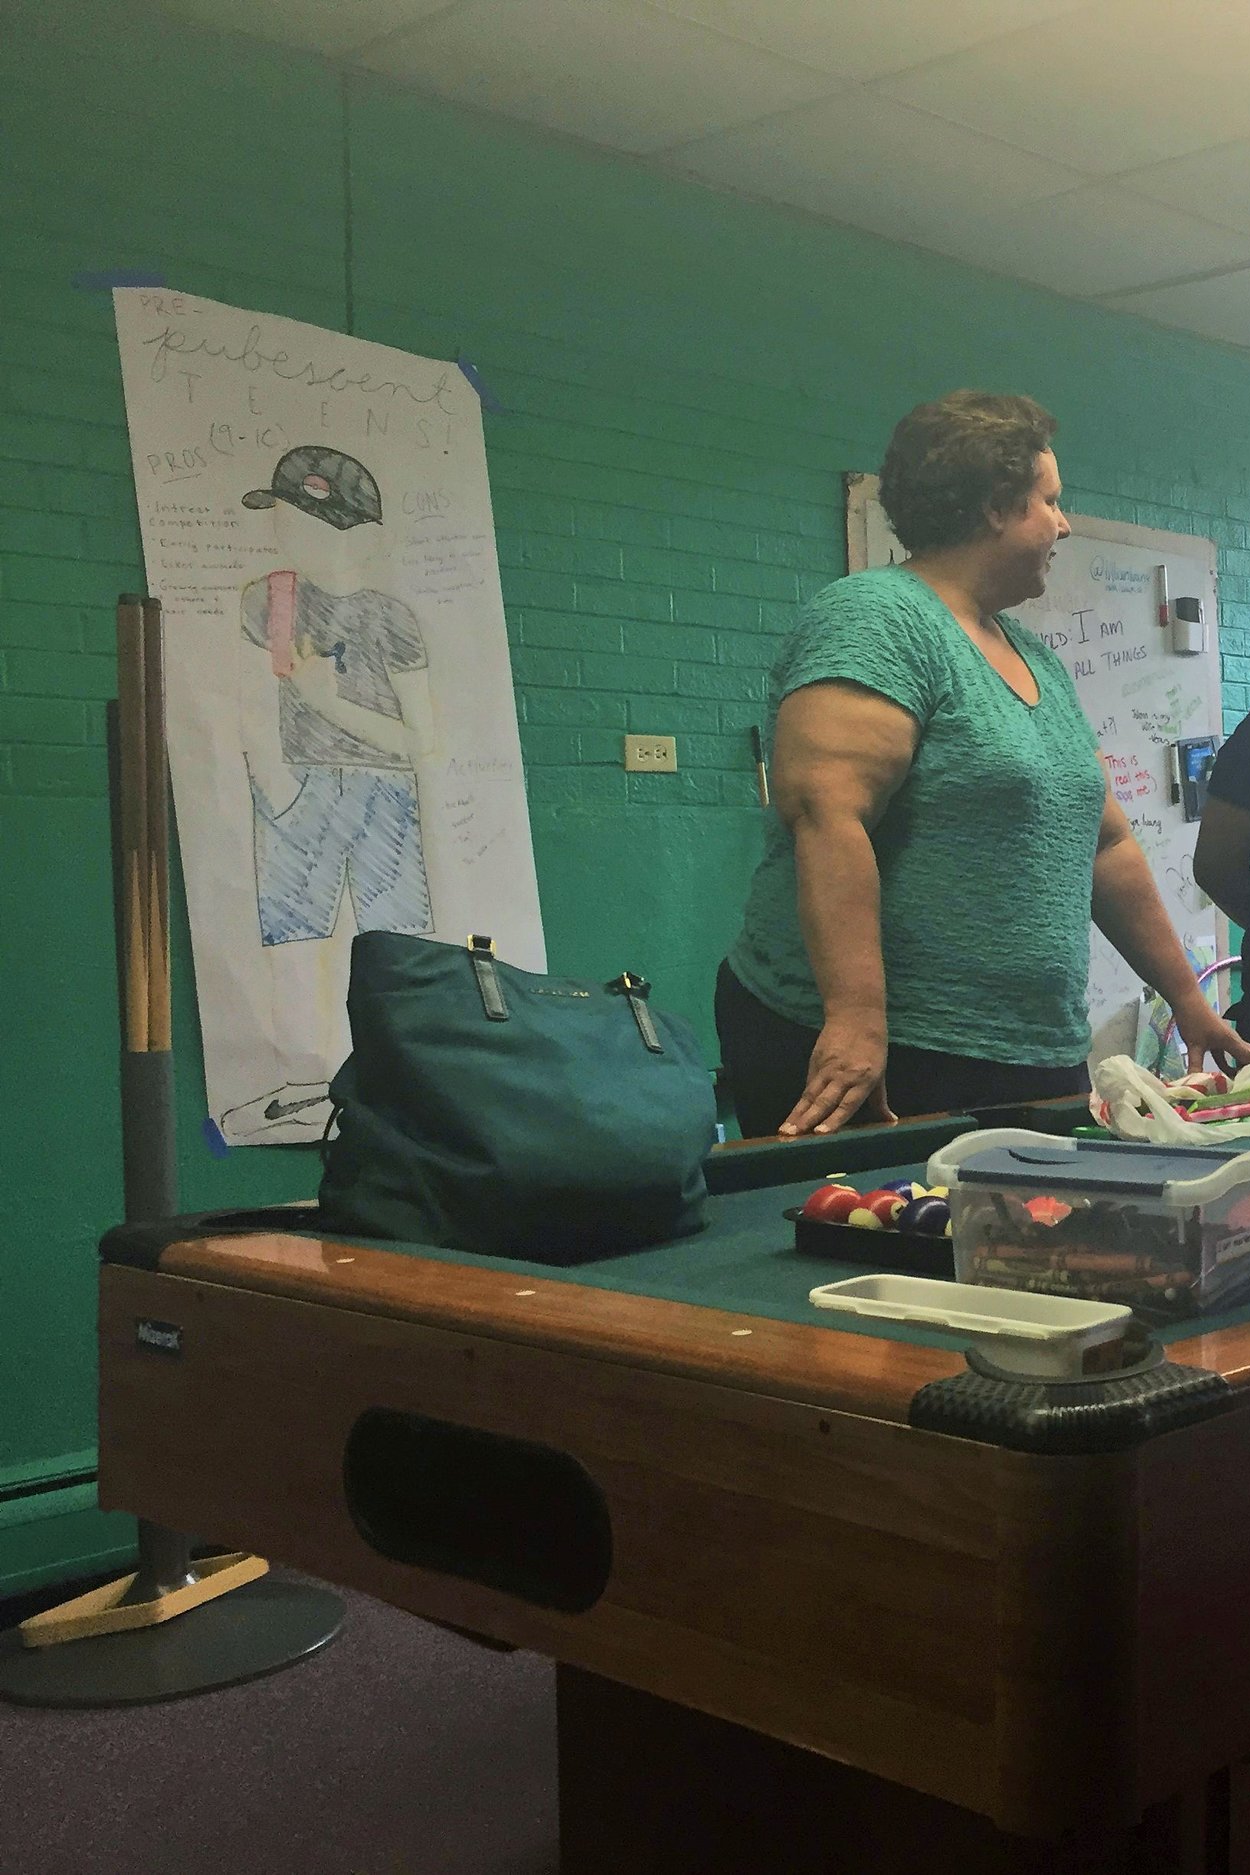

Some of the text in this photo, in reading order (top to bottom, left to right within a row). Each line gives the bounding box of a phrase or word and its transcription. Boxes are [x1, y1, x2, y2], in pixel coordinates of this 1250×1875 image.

[140, 294, 203, 317] PRE-
[142, 324, 457, 416] pubescent
[146, 446, 209, 476] PROS
[1071, 608, 1095, 645] I
[1099, 619, 1124, 639] AM
[1074, 645, 1148, 680] ALL THINGS
[1104, 754, 1127, 770] This
[1114, 772, 1132, 787] real
